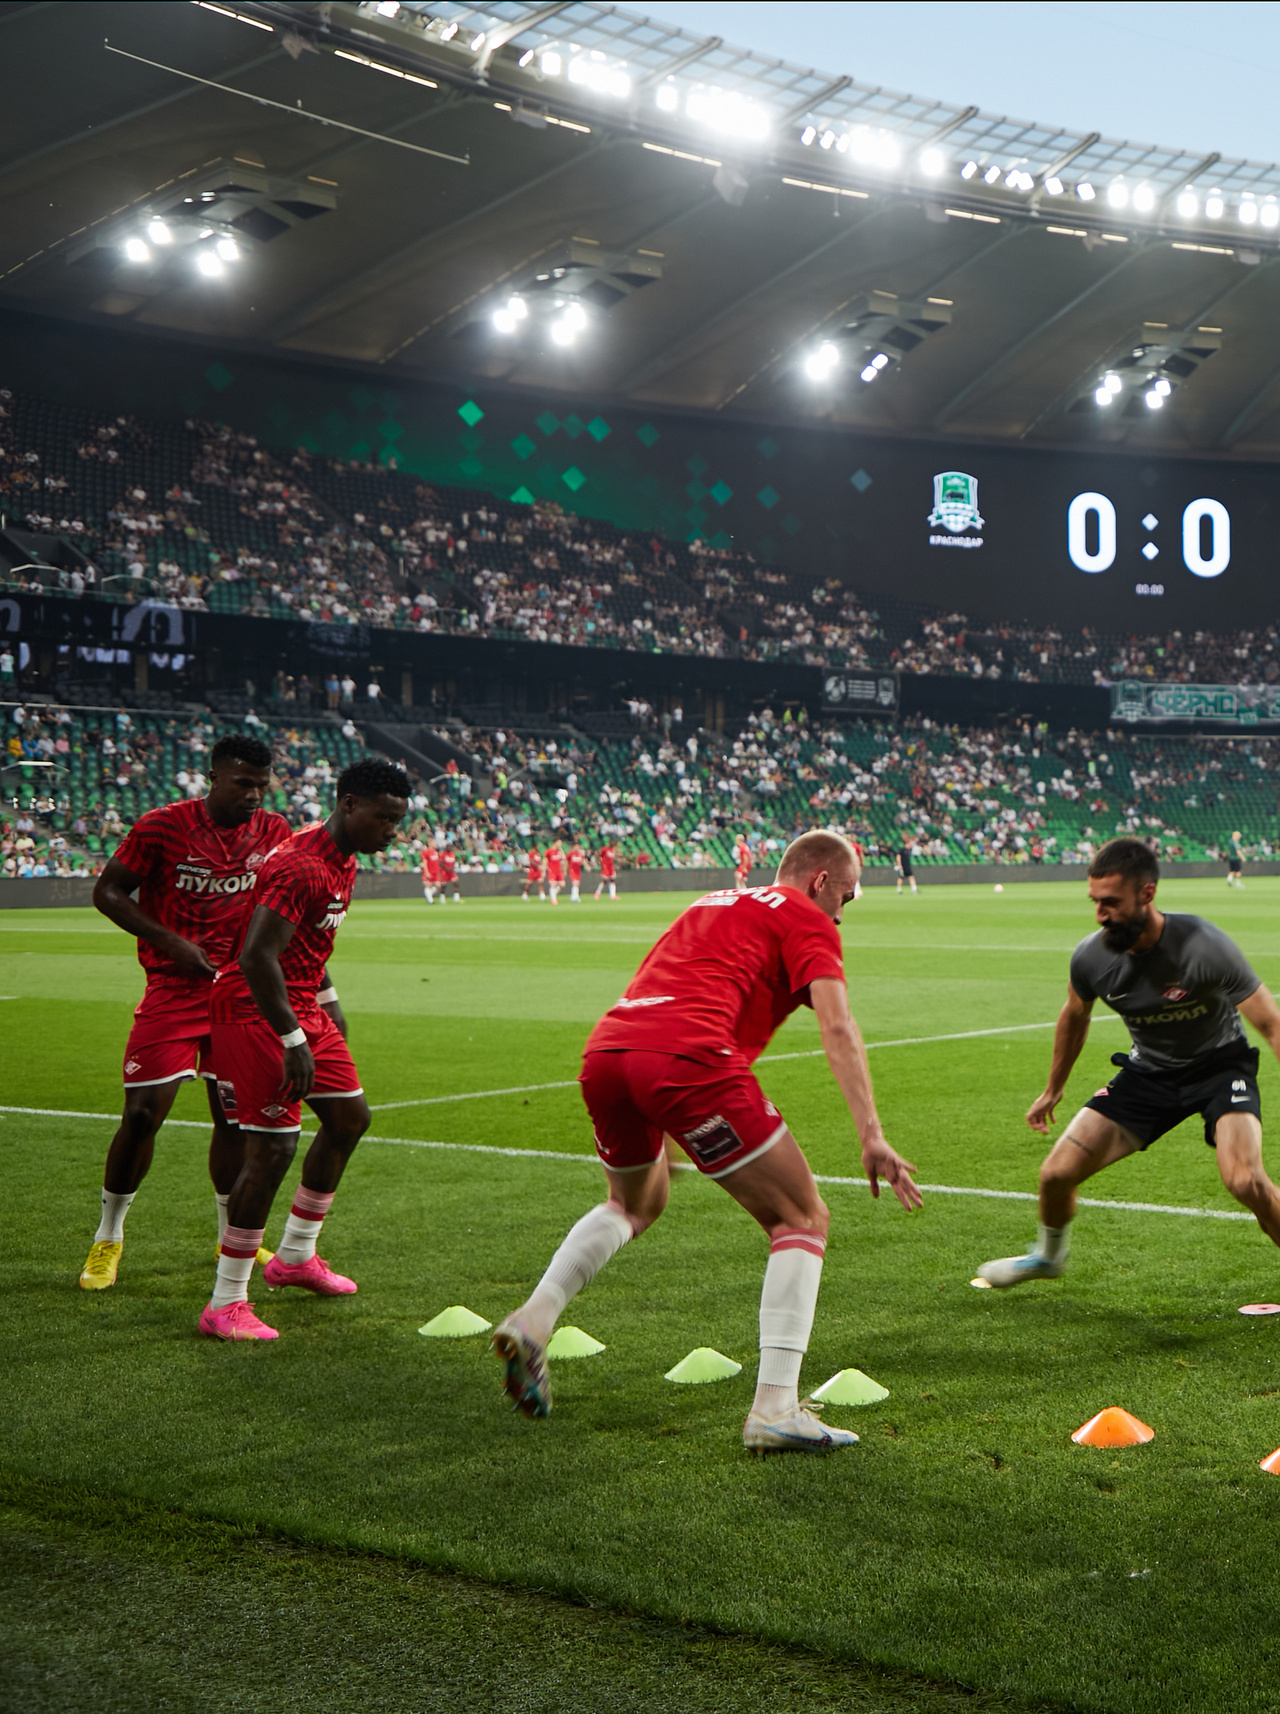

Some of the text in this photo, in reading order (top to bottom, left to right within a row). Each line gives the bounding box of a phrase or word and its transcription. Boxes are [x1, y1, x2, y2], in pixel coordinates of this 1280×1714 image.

[929, 534, 984, 549] КРАСНОДАР
[1068, 491, 1117, 574] 0
[1182, 498, 1231, 578] 0
